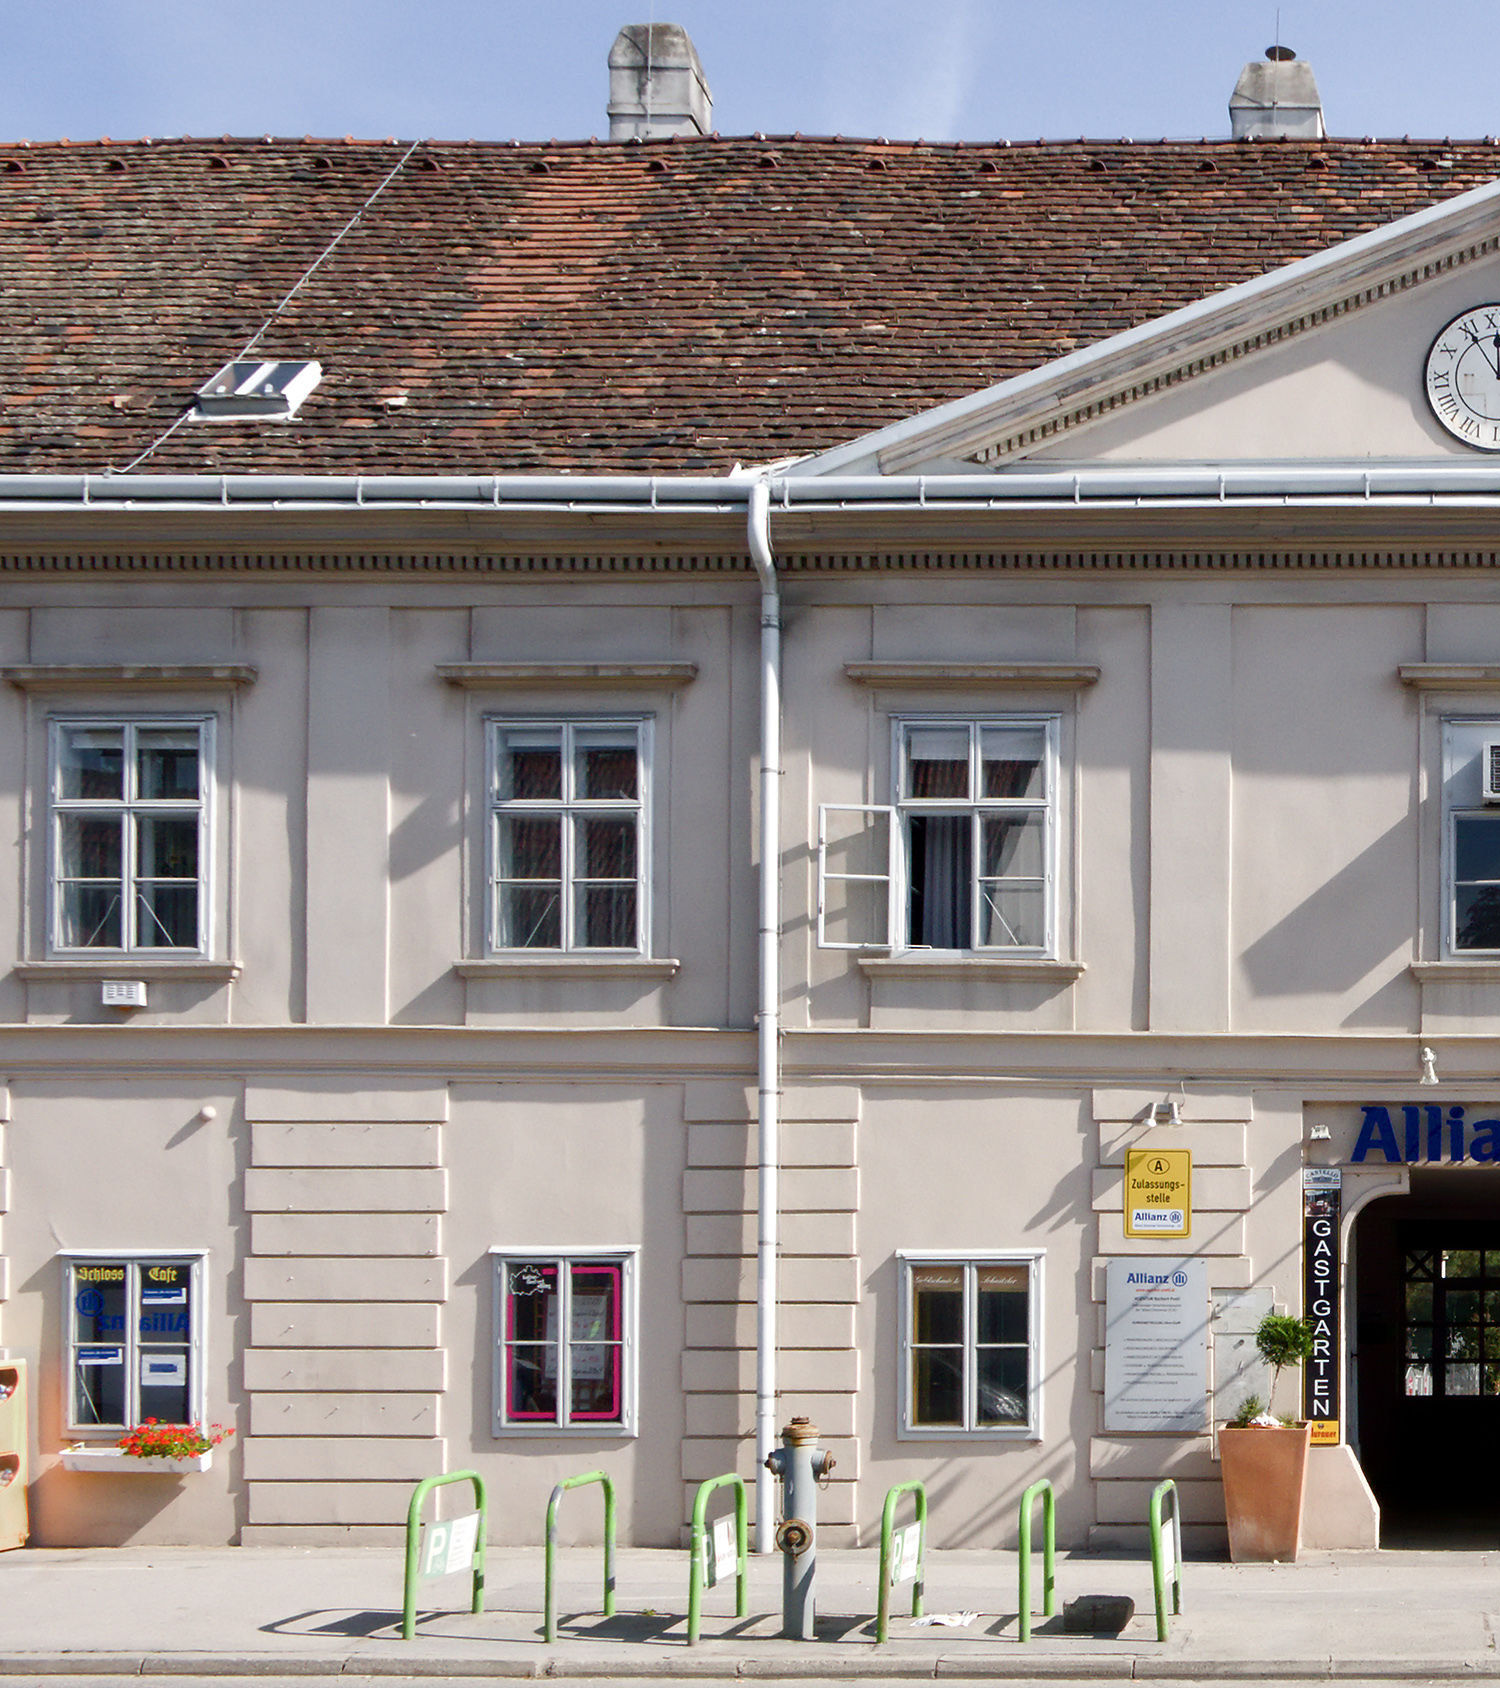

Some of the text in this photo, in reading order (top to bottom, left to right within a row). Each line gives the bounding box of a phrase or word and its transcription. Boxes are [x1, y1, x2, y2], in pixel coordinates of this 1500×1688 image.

[1440, 342, 1458, 360] X
[1434, 370, 1450, 389] IX
[1438, 393, 1461, 422] VIII
[1459, 417, 1481, 438] VII
[1154, 1160, 1163, 1172] A
[1131, 1179, 1185, 1192] Zulassungs-
[1146, 1193, 1170, 1203] stelle
[1134, 1212, 1168, 1221] Allianz
[76, 1266, 178, 1284] Schloss Cafe
[1126, 1273, 1169, 1284] Allianz
[1312, 1219, 1332, 1417] GASTGARTEN
[425, 1526, 447, 1575] P
